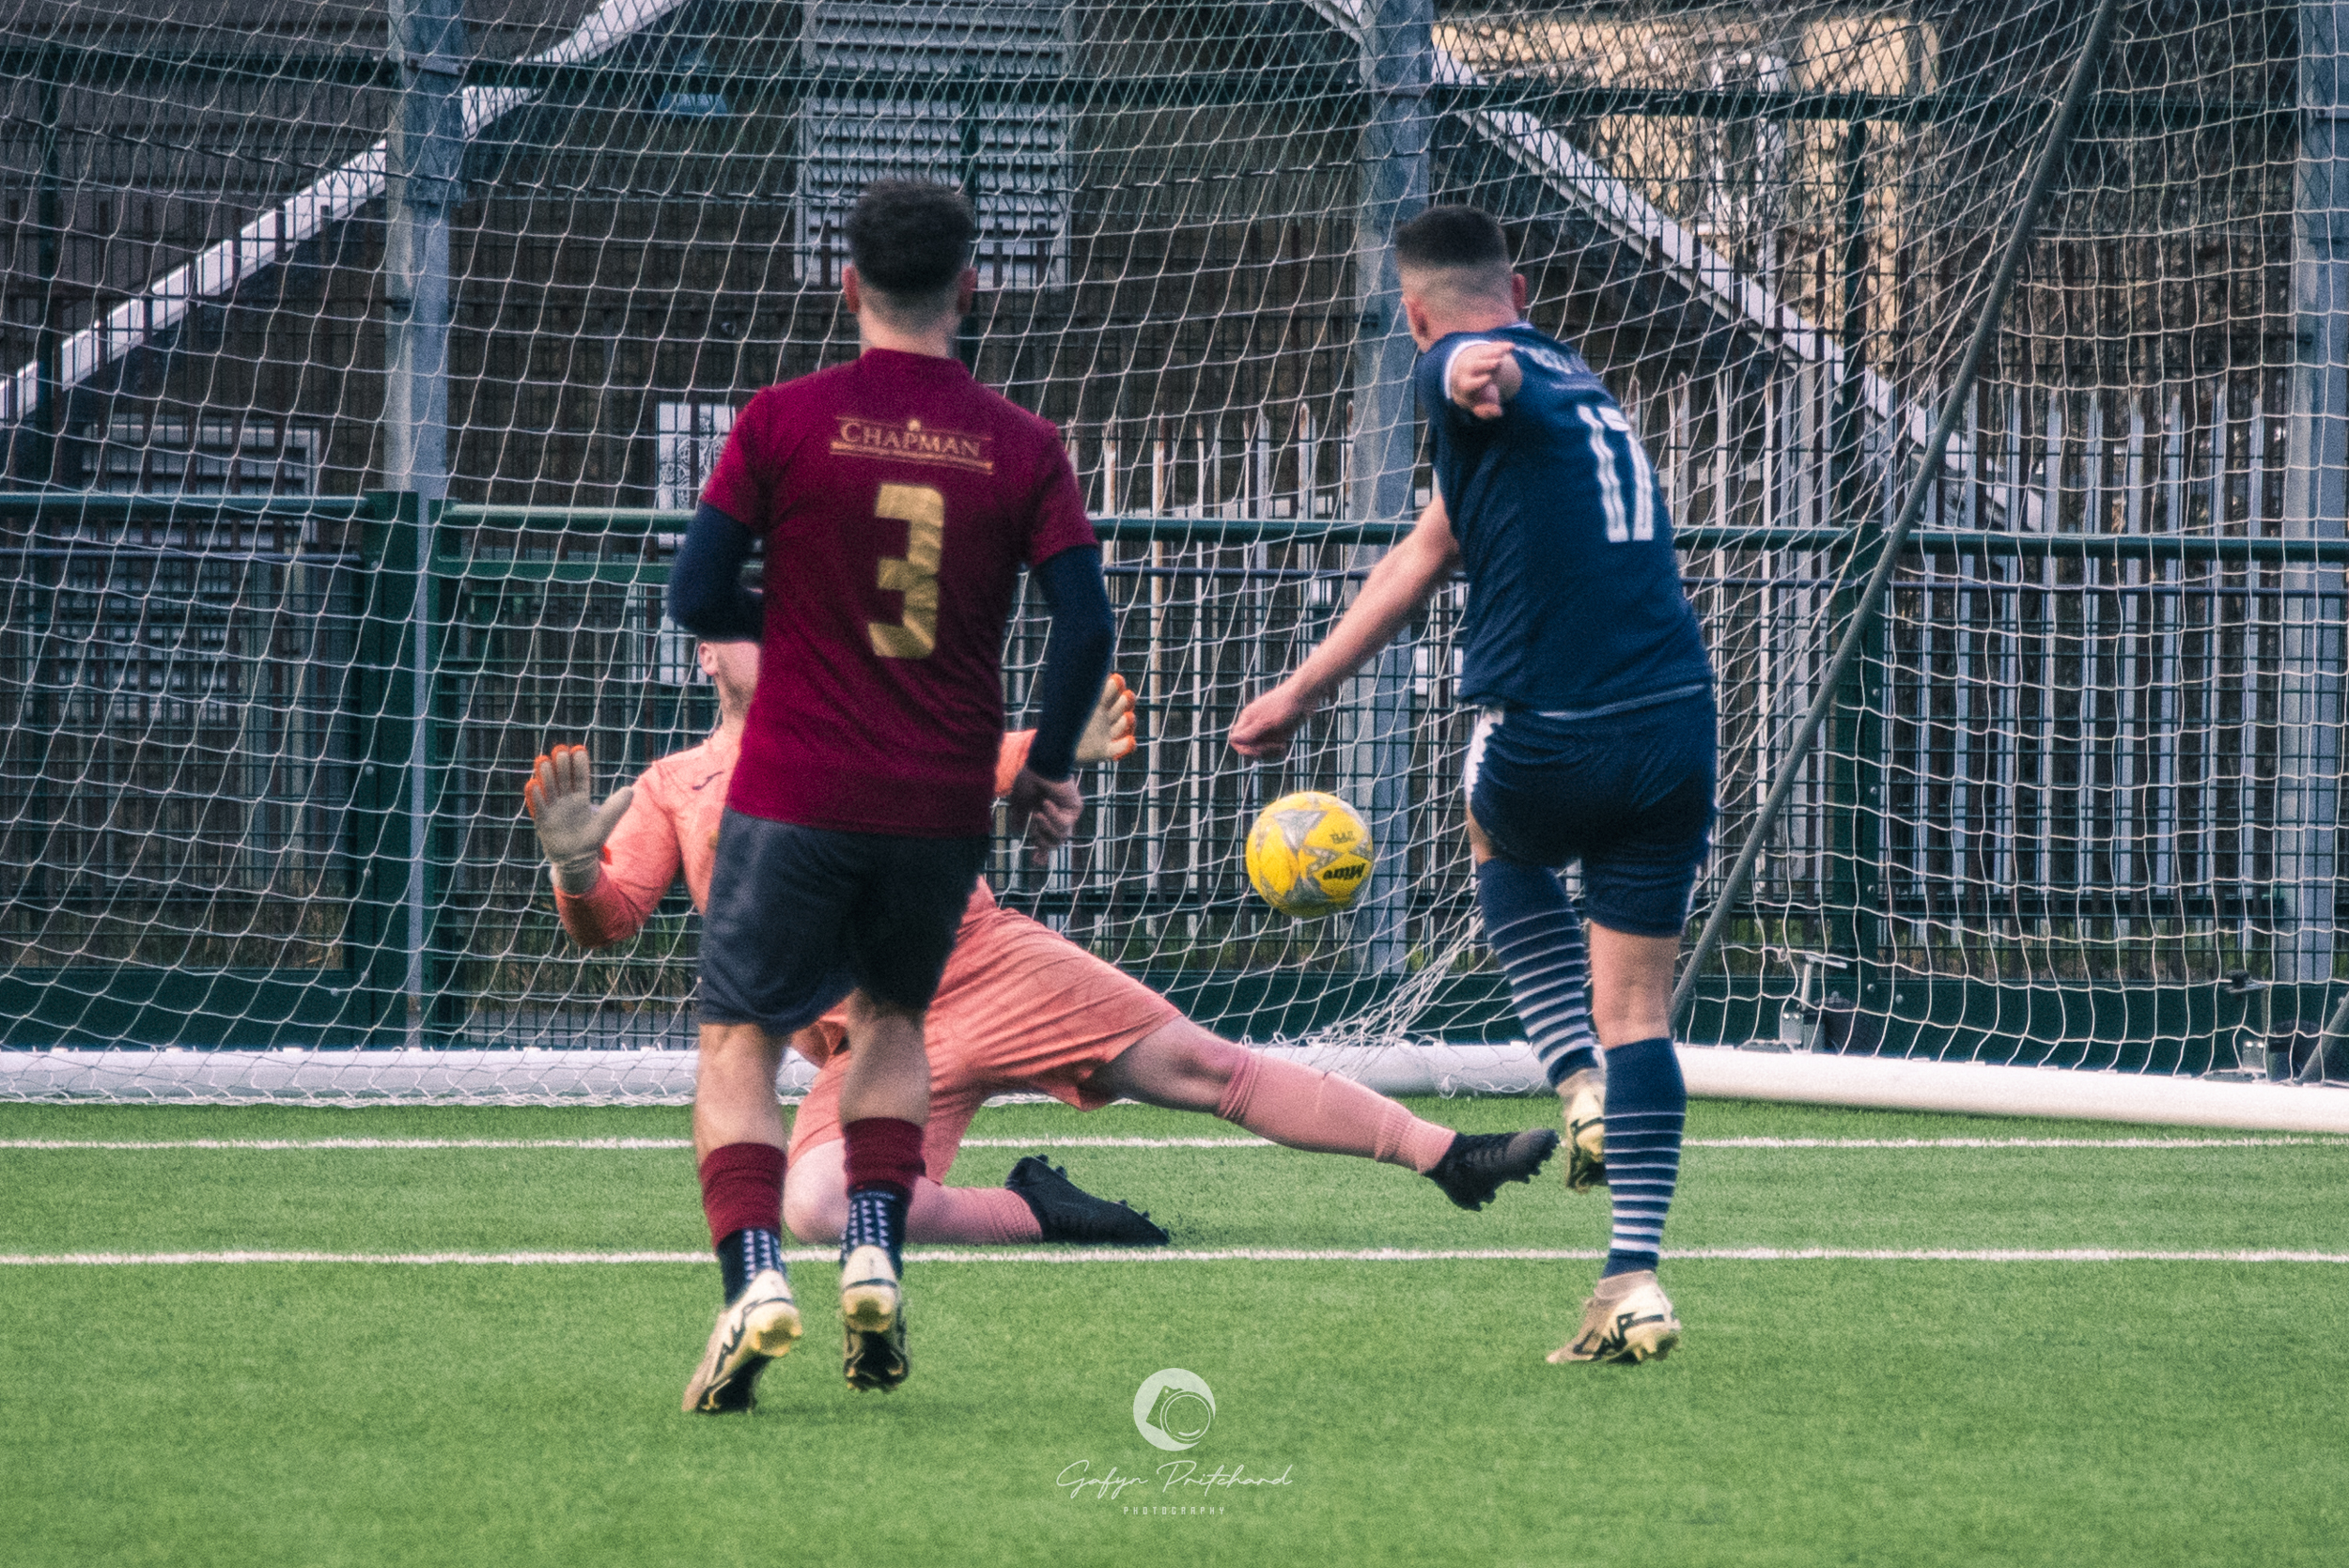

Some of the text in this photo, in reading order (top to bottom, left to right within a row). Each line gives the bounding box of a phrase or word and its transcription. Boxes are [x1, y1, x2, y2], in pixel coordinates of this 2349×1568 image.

[840, 423, 980, 457] CHAPMAN
[1577, 404, 1654, 543] 17
[868, 483, 944, 659] 3
